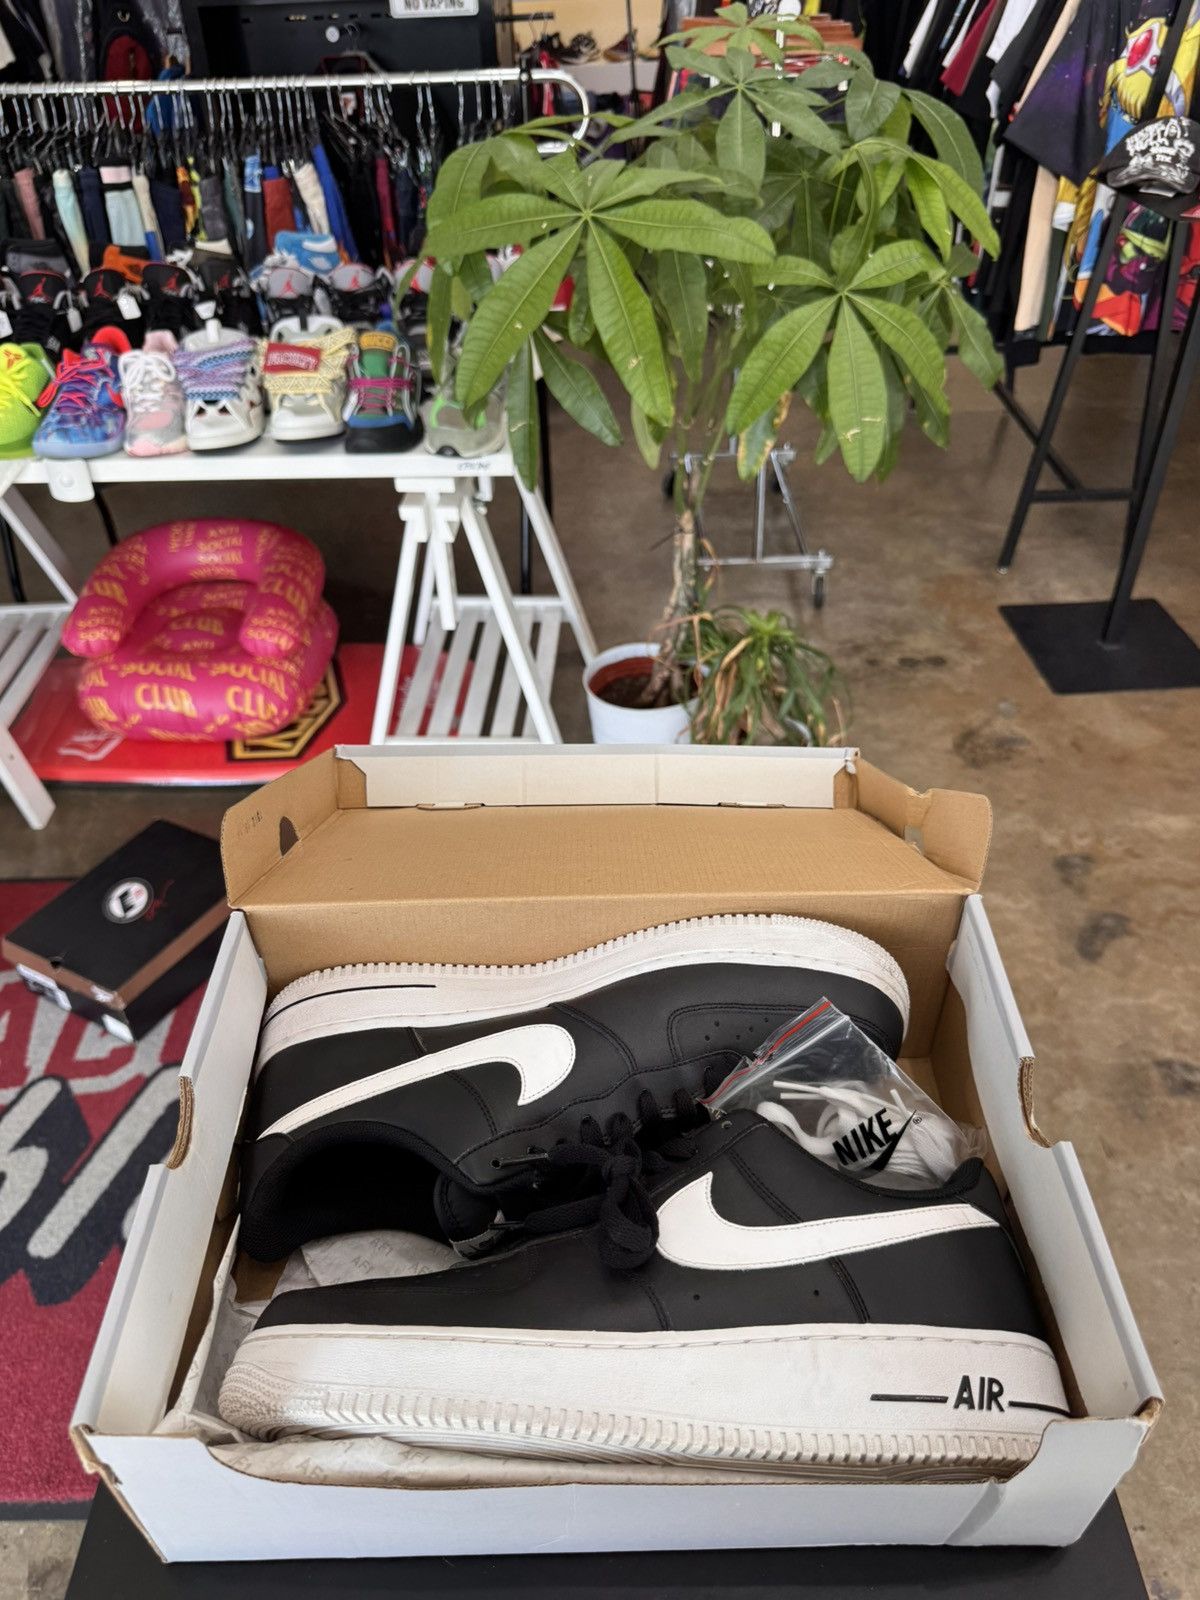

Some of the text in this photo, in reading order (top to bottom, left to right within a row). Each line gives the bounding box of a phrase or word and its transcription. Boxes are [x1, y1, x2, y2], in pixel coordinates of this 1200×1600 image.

[134, 682, 198, 718] CLUB
[832, 1108, 897, 1166] NIKE
[953, 1375, 1005, 1412] AIR
